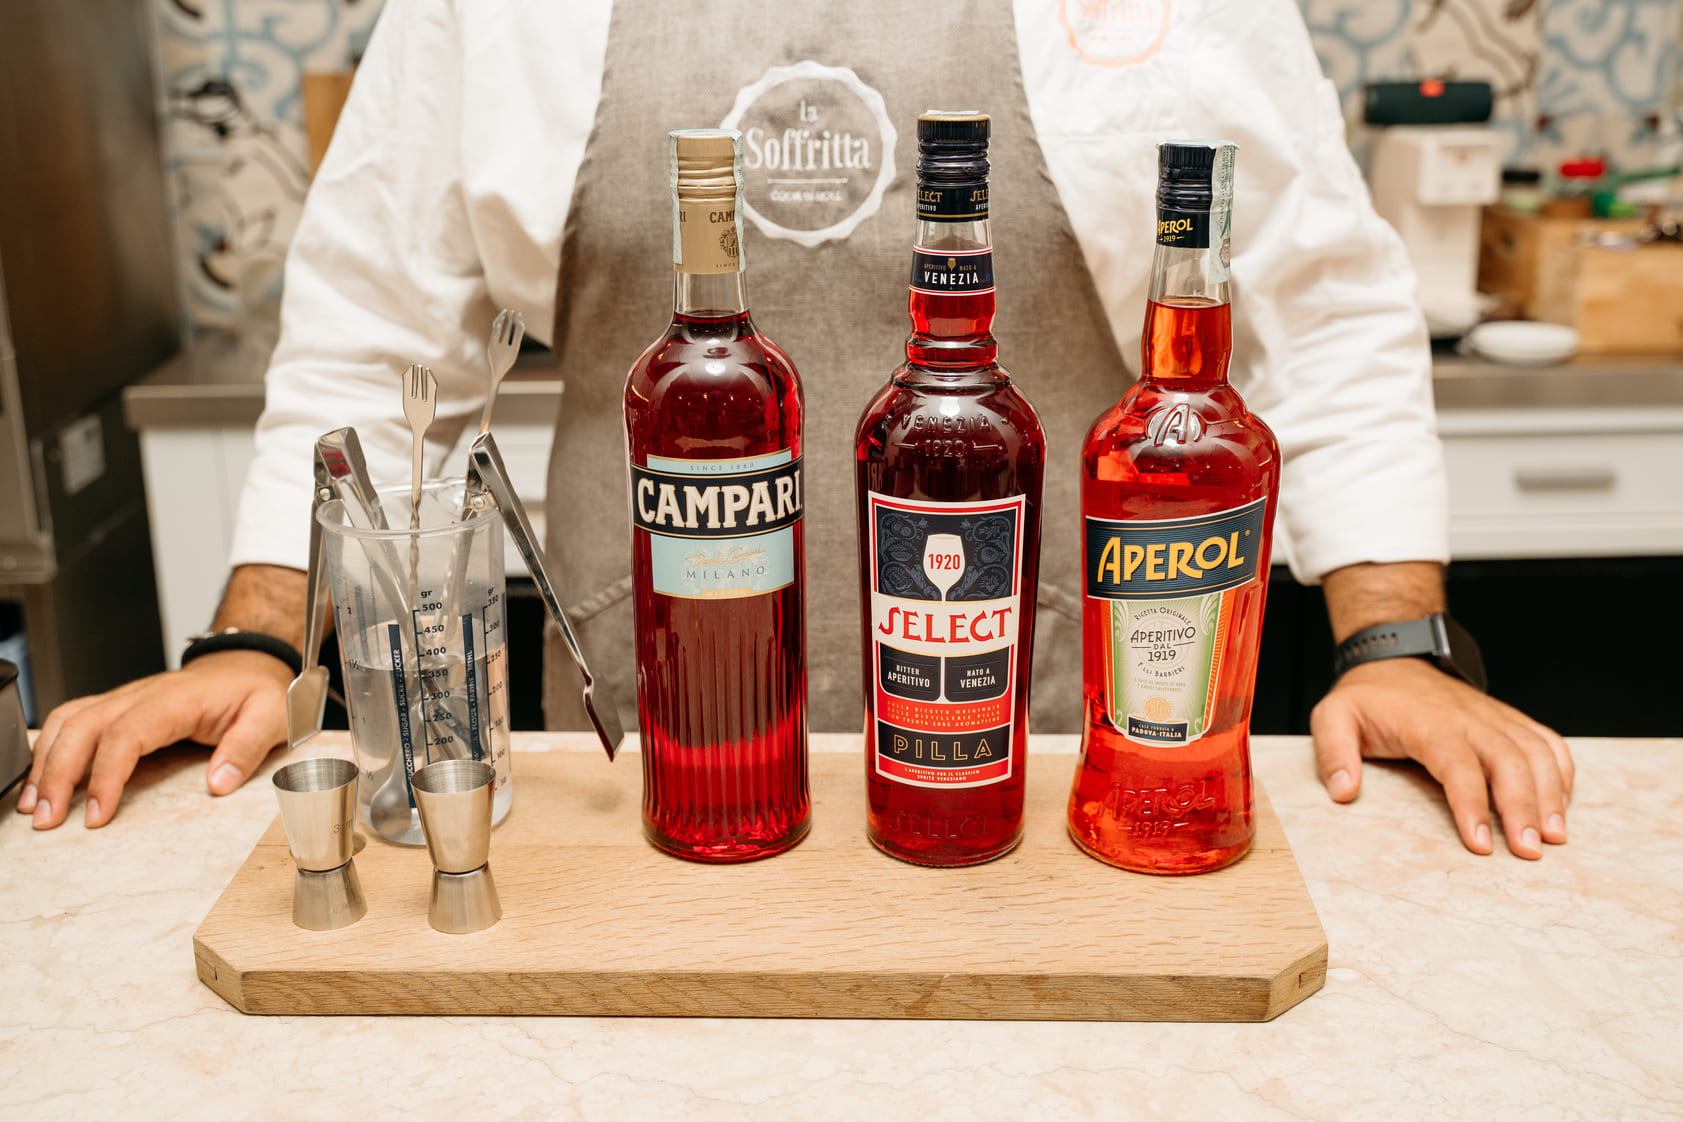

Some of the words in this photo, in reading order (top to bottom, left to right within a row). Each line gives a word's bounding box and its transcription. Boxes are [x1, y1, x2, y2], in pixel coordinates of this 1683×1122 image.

[800, 99, 818, 122] la
[744, 127, 873, 171] Soffritta
[1163, 234, 1176, 243] 1919
[924, 271, 980, 285] VENEZIA
[900, 413, 993, 434] VENEZIA
[1154, 403, 1191, 447] A
[924, 439, 967, 458] 1920
[690, 464, 723, 472] SINCE
[730, 462, 755, 471] 1860
[637, 469, 802, 529] CAMPARI
[928, 553, 961, 570] 1920
[1097, 530, 1246, 586] APEROL
[686, 565, 766, 580] MILANO
[420, 590, 433, 598] gr
[488, 594, 499, 607] 350
[422, 602, 443, 612] 500
[1134, 608, 1158, 620] RICETTA
[1159, 606, 1192, 626] ORIGINALE
[423, 624, 445, 634] 450
[489, 620, 500, 633] 300
[878, 606, 1013, 644] SELECT
[1130, 626, 1196, 643] APERITIVO
[425, 646, 447, 656] 400
[1147, 649, 1177, 662] 1919
[428, 668, 449, 678] 350
[896, 664, 920, 676] BITTER
[966, 668, 983, 677] NATO
[984, 667, 990, 675] A
[887, 671, 930, 688] APERITIVO
[960, 675, 996, 689] VENEZIA
[398, 684, 406, 707] SUCRE
[430, 690, 450, 701] 300
[432, 712, 452, 722] 250
[401, 712, 409, 737] SUGAR
[1131, 726, 1183, 738] PADOVA-ITALIA
[434, 736, 454, 746] 200
[893, 734, 993, 761] PILLA
[1101, 780, 1216, 821] APEROL
[1132, 820, 1173, 837] 1919
